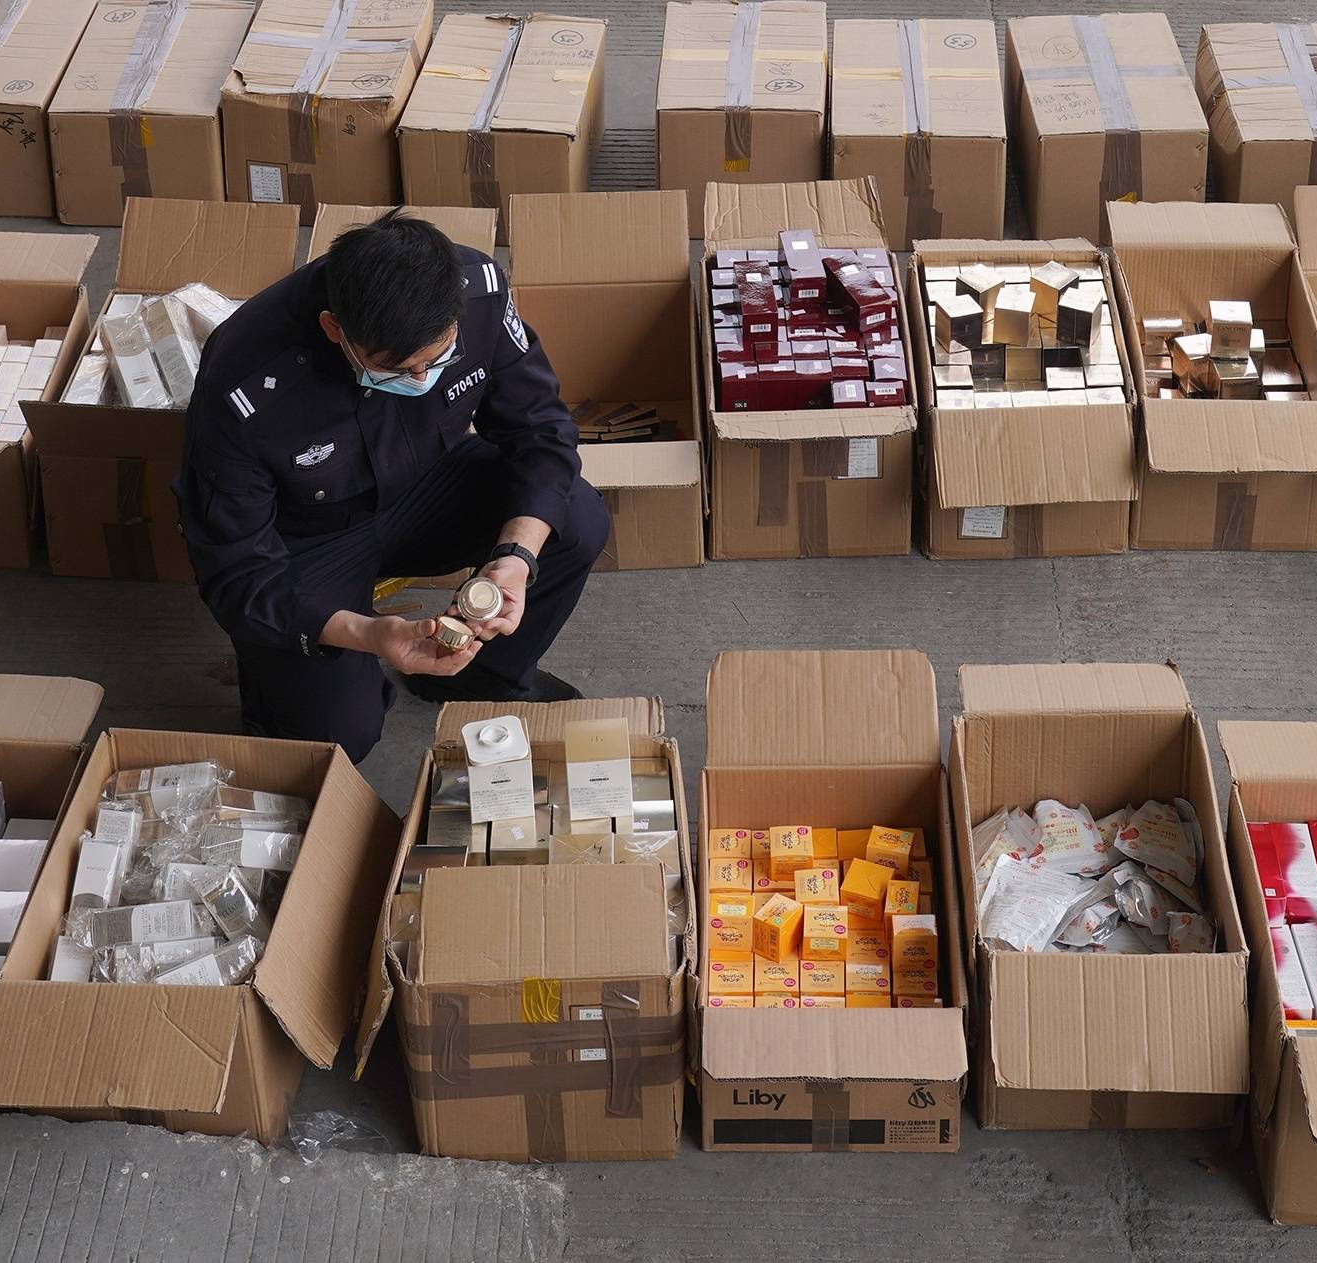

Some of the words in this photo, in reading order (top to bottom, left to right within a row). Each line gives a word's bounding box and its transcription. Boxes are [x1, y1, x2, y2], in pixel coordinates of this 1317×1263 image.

[771, 77, 799, 91] 52
[447, 367, 487, 401] 570478
[733, 1089, 787, 1111] Liby
